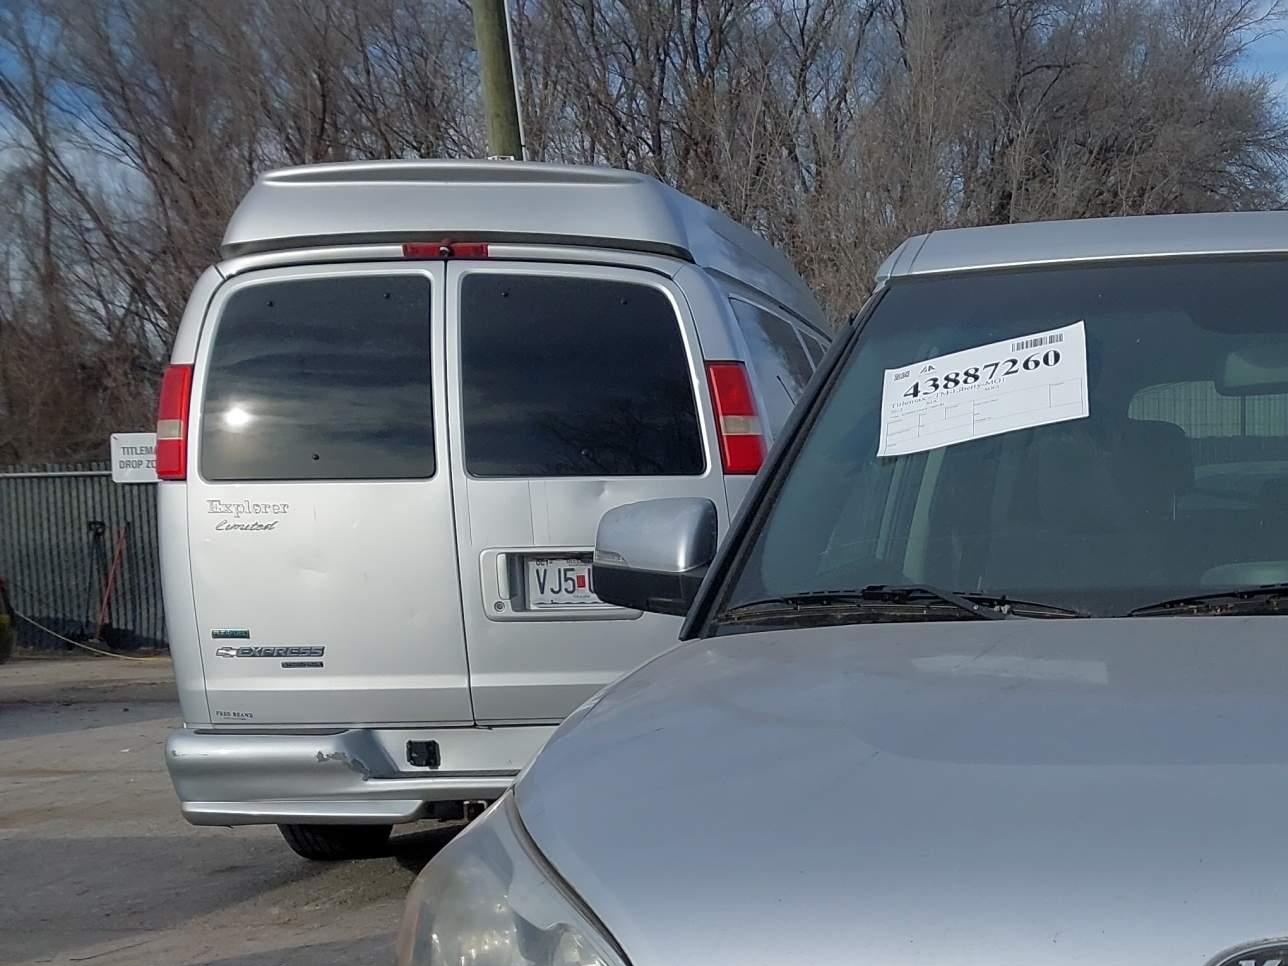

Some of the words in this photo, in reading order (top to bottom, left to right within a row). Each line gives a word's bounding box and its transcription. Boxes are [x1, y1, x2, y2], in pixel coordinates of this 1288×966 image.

[903, 349, 1061, 399] 43887260
[119, 459, 144, 469] DROP
[206, 499, 289, 518] Explorer
[239, 646, 324, 658] EXPRESS
